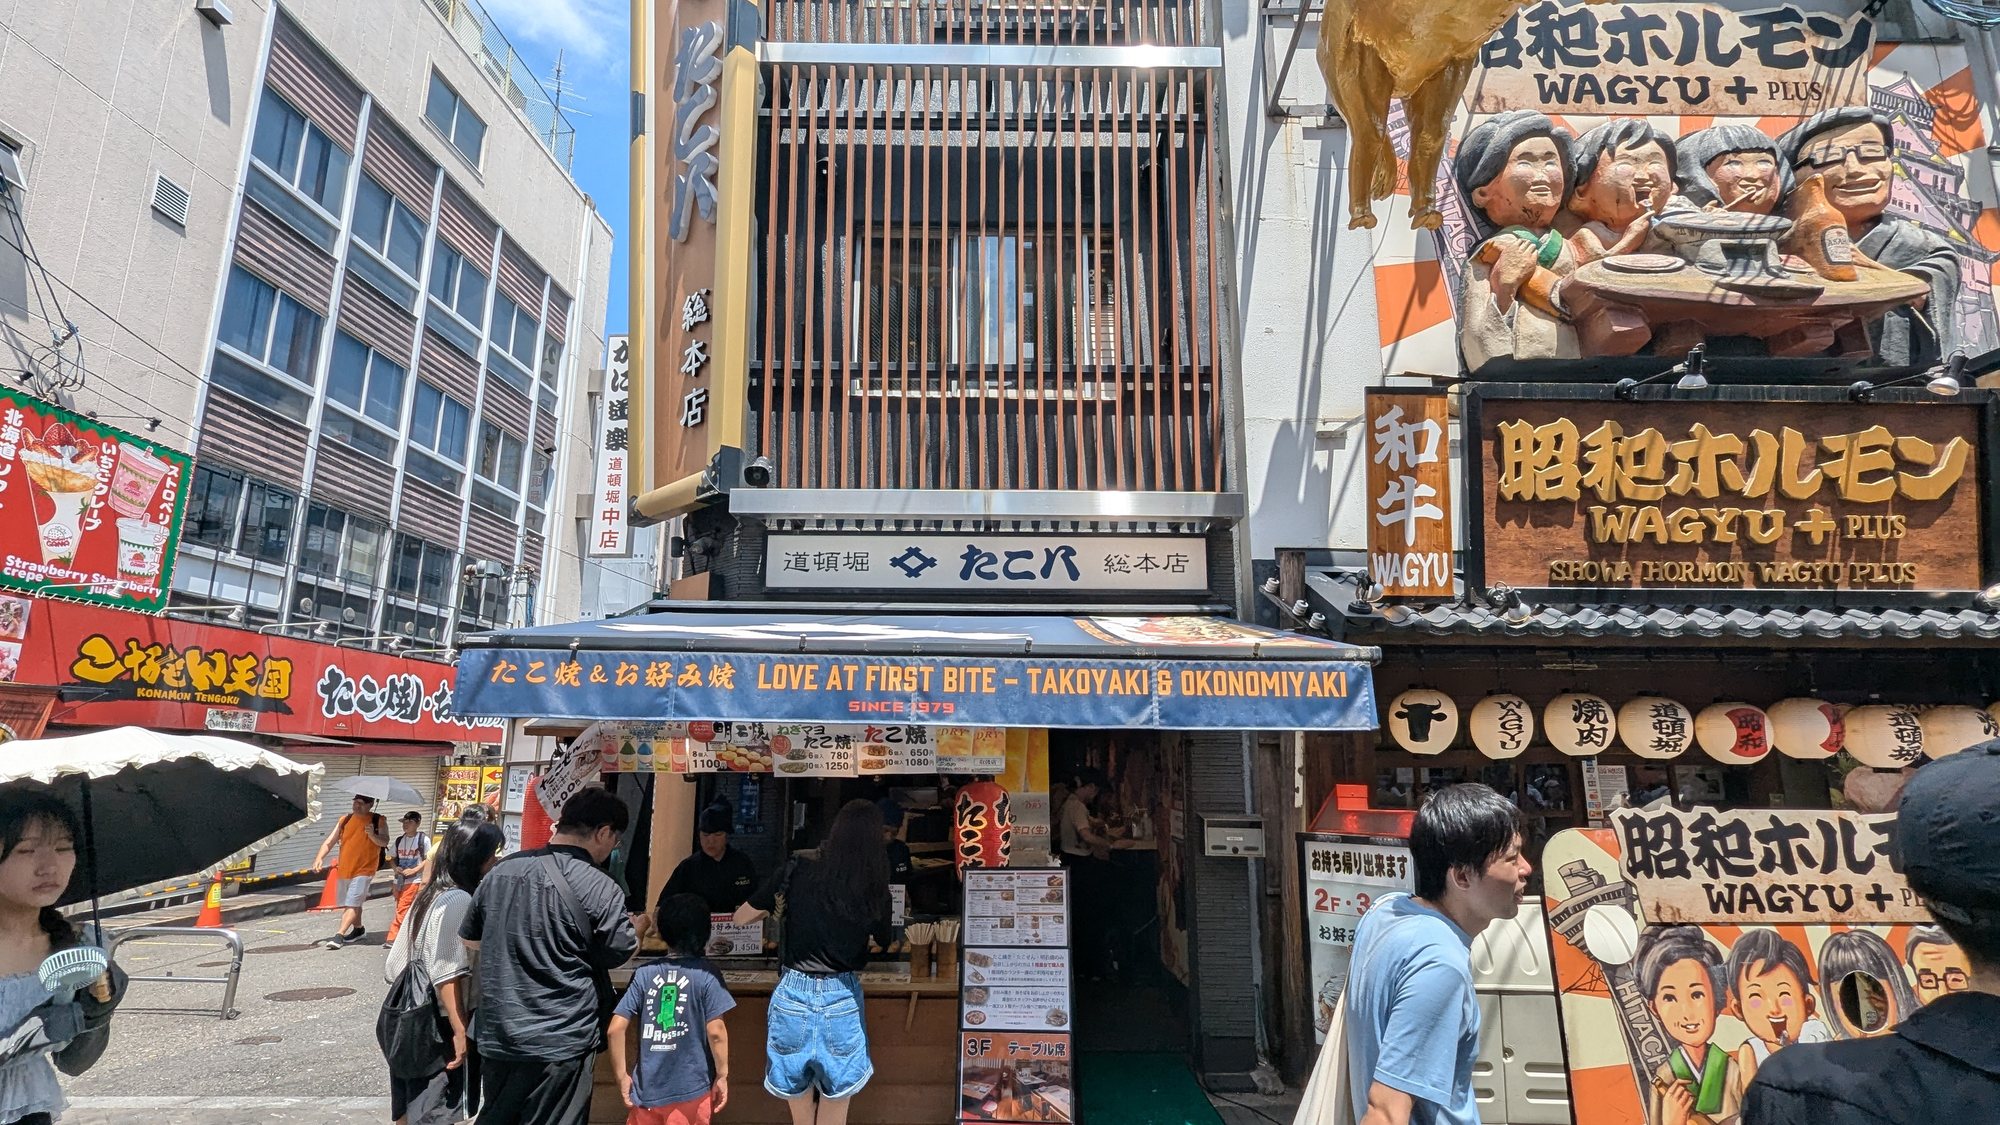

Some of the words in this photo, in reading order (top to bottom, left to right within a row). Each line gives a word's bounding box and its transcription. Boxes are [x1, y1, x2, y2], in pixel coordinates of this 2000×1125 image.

[1533, 72, 1711, 104] WAGYU
[1768, 81, 1822, 101] PLUS
[668, 21, 723, 243] たこ八
[680, 288, 709, 428] 総本店
[1374, 404, 1443, 547] 和牛
[1497, 416, 1970, 503] 昭和ホルモン
[85, 442, 117, 530] いちごクレープ
[599, 457, 623, 549] 道頓堀中店
[148, 464, 181, 575] ストロベリージュース
[1587, 504, 1786, 544] WAGYU
[1847, 514, 1907, 540] PLUS
[3, 566, 44, 583] crepe
[5, 554, 88, 583] Strawberry
[783, 551, 870, 573] 道頓堀
[958, 544, 1081, 581] たこ八
[1103, 553, 1190, 574] 総本店
[1372, 552, 1448, 587] WAGYU
[1551, 560, 1633, 583] SHOWA
[1642, 560, 1749, 584] HORMON
[1757, 561, 1842, 584] WAGYU
[1847, 561, 1918, 584] PLUS
[136, 687, 192, 701] KONAMON
[194, 691, 240, 705] TENGOKU
[757, 663, 818, 690] LOVE
[826, 664, 860, 690] AT
[865, 664, 935, 692] FIRST
[943, 667, 997, 693] BITE
[1027, 668, 1149, 695] TAKOYAKI
[1157, 669, 1173, 695] &
[1181, 670, 1348, 698] OKONOMIYAKI
[848, 701, 904, 713] SINCE
[911, 702, 954, 714] 1979
[1571, 698, 1608, 747] 焼肉
[777, 724, 825, 735] ねぎマヨ
[864, 725, 928, 744] たこ焼
[941, 727, 967, 736] DRY
[976, 731, 1001, 740] DRY
[1493, 701, 1523, 750] WAGYU
[1649, 703, 1688, 753] 道頓堀
[1886, 711, 1923, 761] 道頓堀
[1312, 849, 1408, 880] お持ち帰り出来ます
[1702, 883, 1854, 914] WAGYU
[966, 1039, 992, 1056] 3F
[1008, 1041, 1067, 1057] テーブル席
